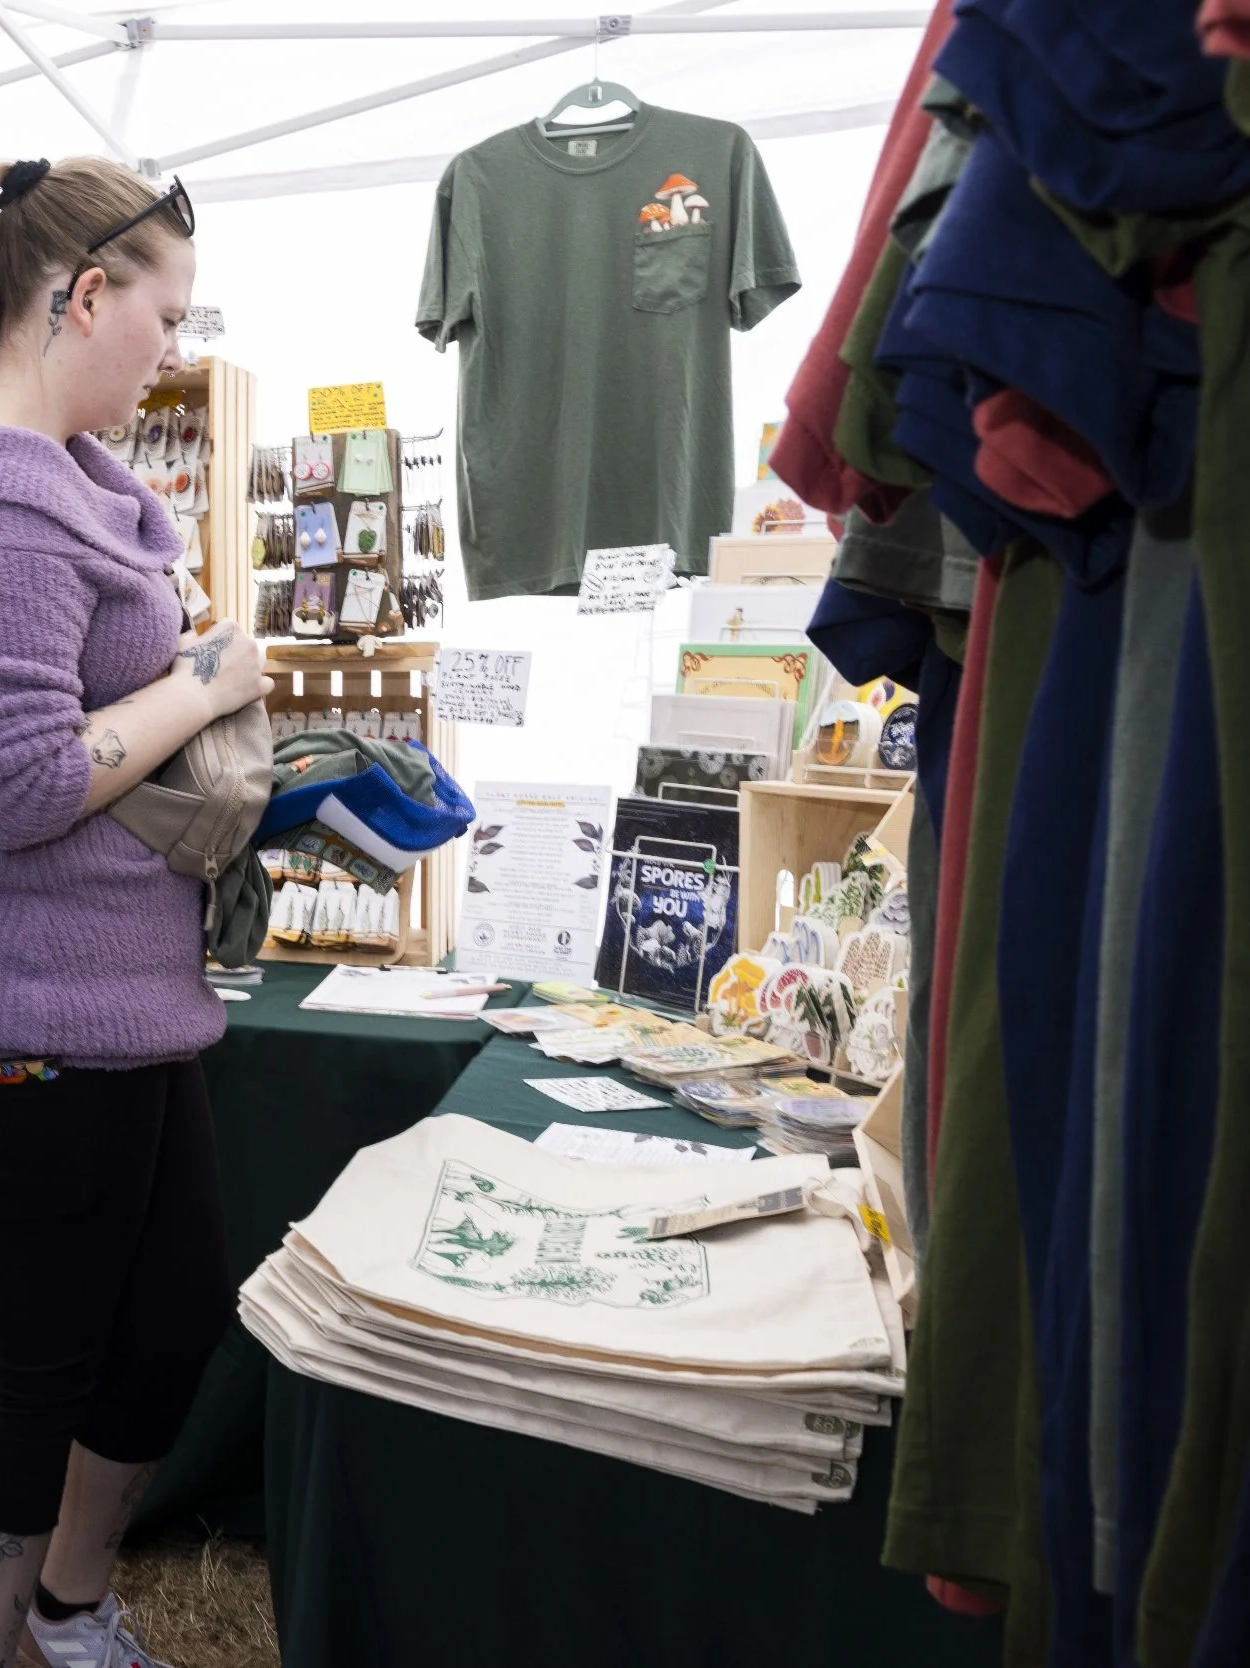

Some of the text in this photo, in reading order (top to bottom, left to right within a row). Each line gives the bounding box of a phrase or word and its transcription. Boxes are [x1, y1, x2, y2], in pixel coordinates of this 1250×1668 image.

[351, 383, 374, 394] OFF
[451, 651, 525, 676] 25% OFF
[640, 865, 705, 891] SPORES
[669, 889, 680, 899] BE
[652, 895, 688, 918] YOU
